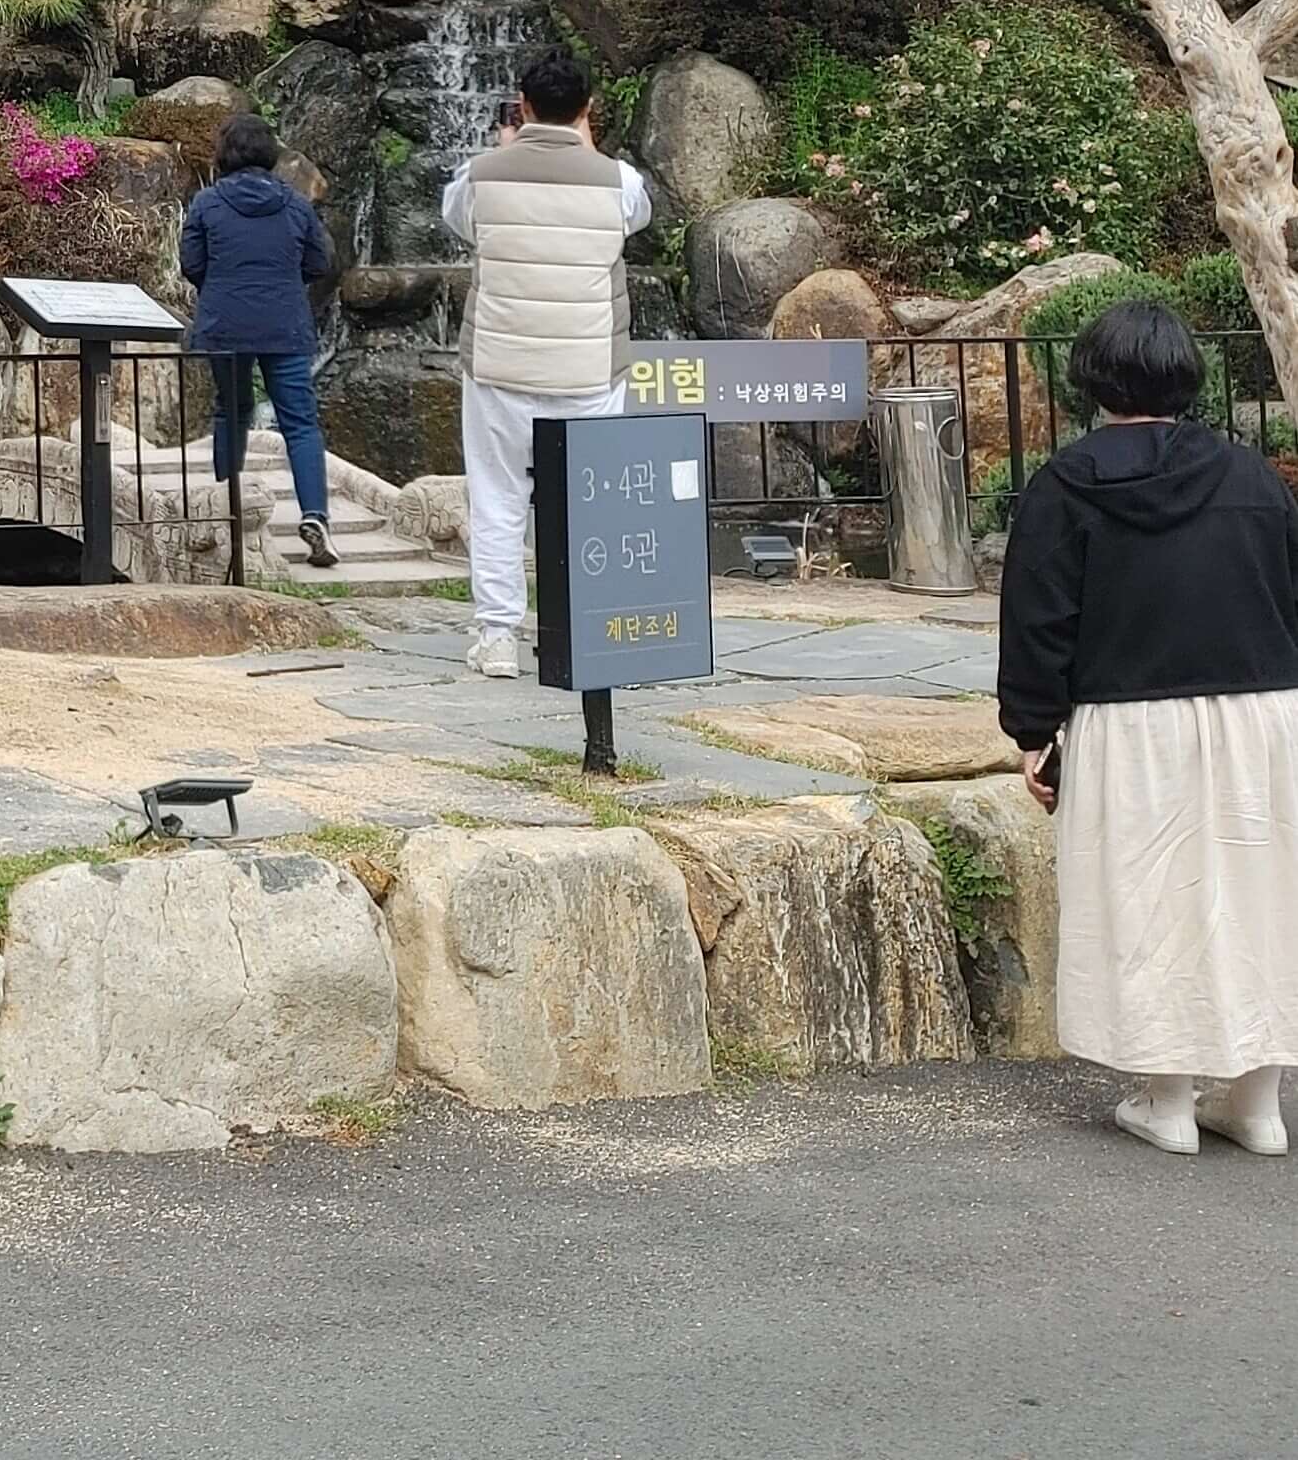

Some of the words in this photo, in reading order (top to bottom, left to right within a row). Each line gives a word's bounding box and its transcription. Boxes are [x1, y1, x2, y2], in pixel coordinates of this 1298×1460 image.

[628, 358, 705, 405] 위험
[735, 382, 847, 404] 낙상위험주의
[621, 529, 659, 574] 5관
[606, 611, 678, 642] 계단조심
